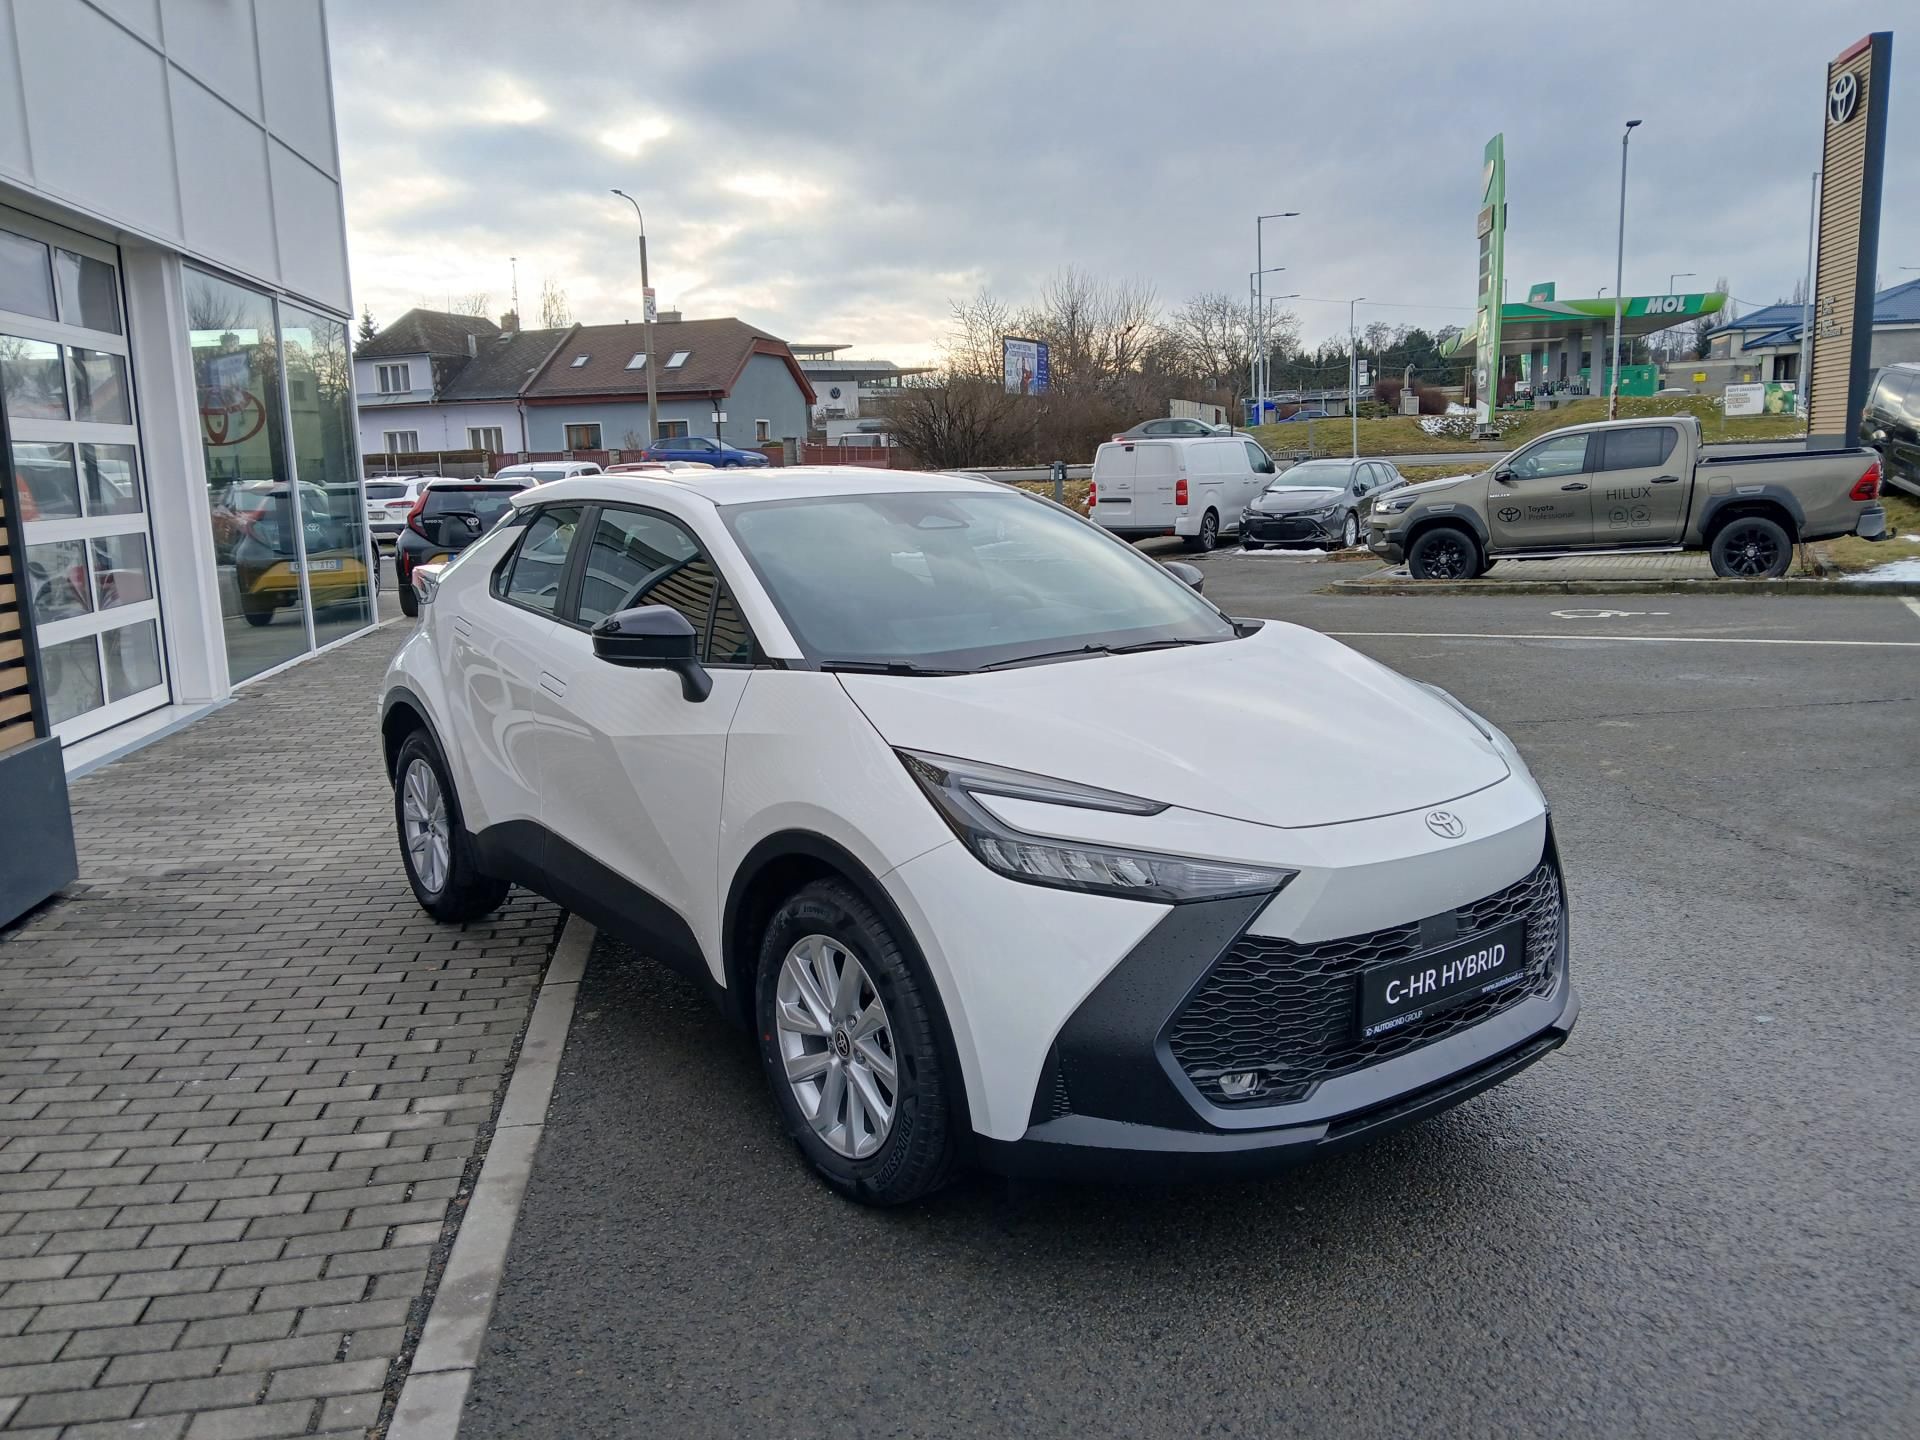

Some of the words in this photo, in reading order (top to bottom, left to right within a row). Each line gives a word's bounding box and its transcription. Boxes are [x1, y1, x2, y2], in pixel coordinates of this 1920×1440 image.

[1644, 296, 1687, 314] MOL
[1606, 486, 1652, 501] HILUX
[1527, 505, 1554, 513] Toyota
[1385, 968, 1437, 1005] C-HR
[1441, 943, 1506, 987] HYBRID
[1481, 971, 1525, 993] www.autobond.cz
[1373, 1016, 1405, 1034] AUTOBOND
[1404, 1010, 1423, 1023] GROUP
